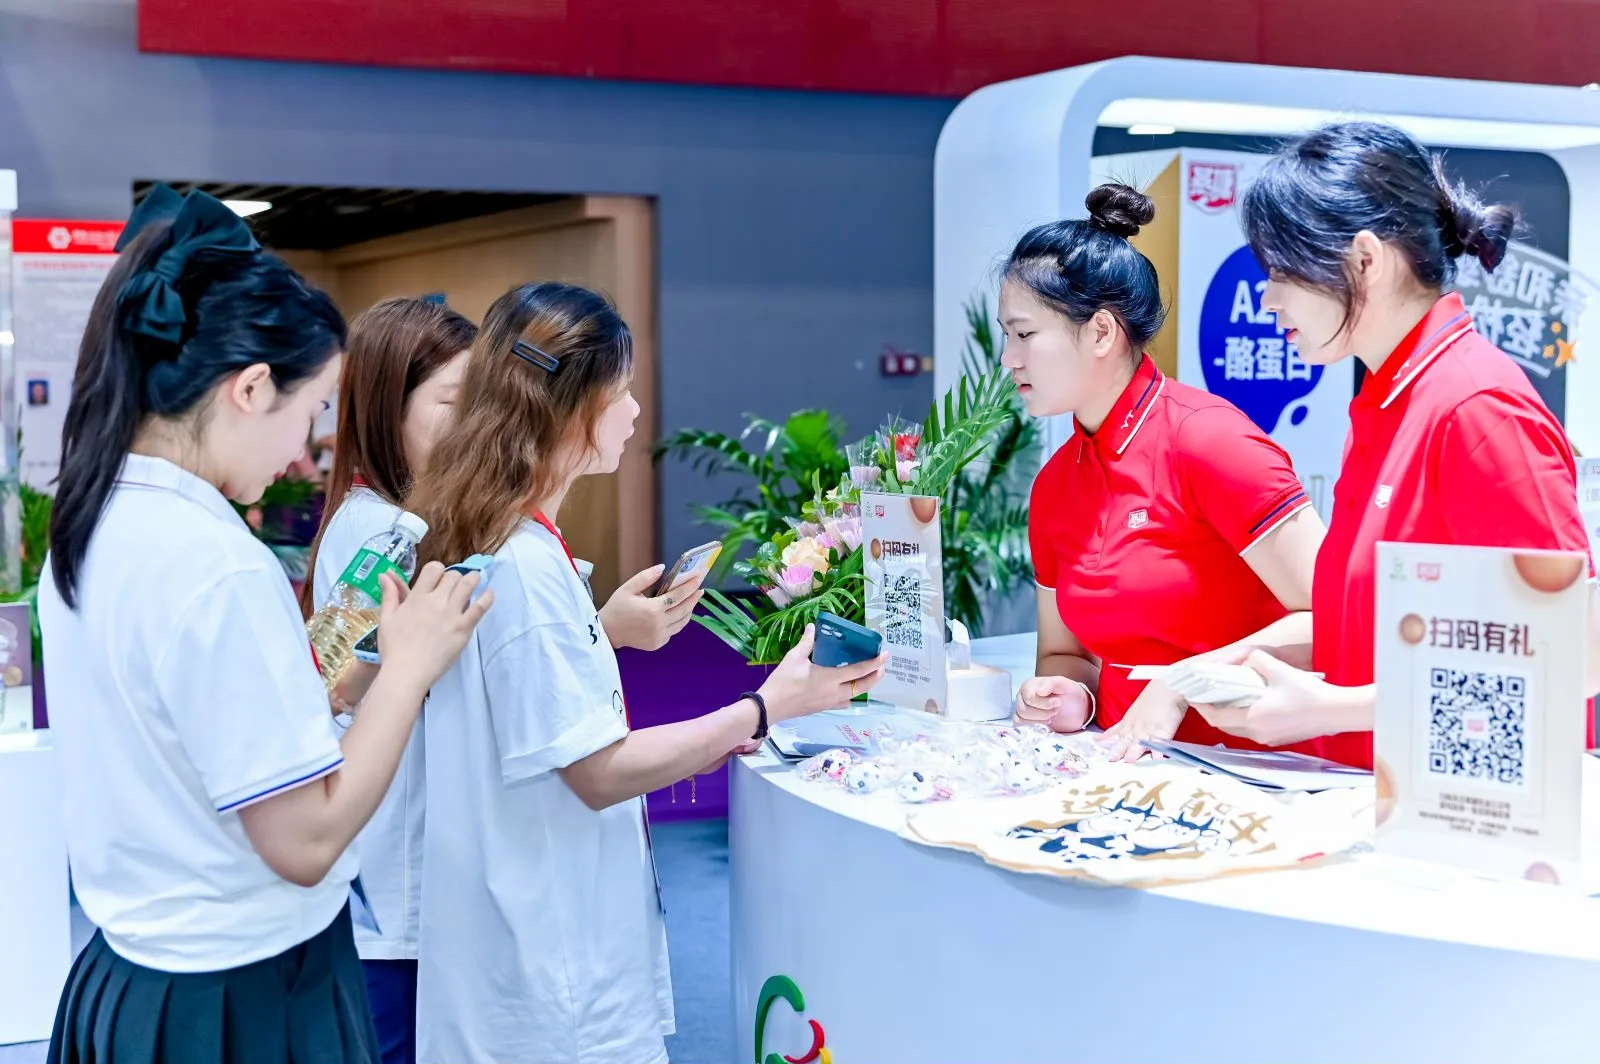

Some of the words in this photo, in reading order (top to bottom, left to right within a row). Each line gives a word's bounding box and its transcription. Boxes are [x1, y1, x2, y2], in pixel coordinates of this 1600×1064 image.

[1229, 279, 1285, 335] A2
[1429, 617, 1535, 657] 扫码有礼
